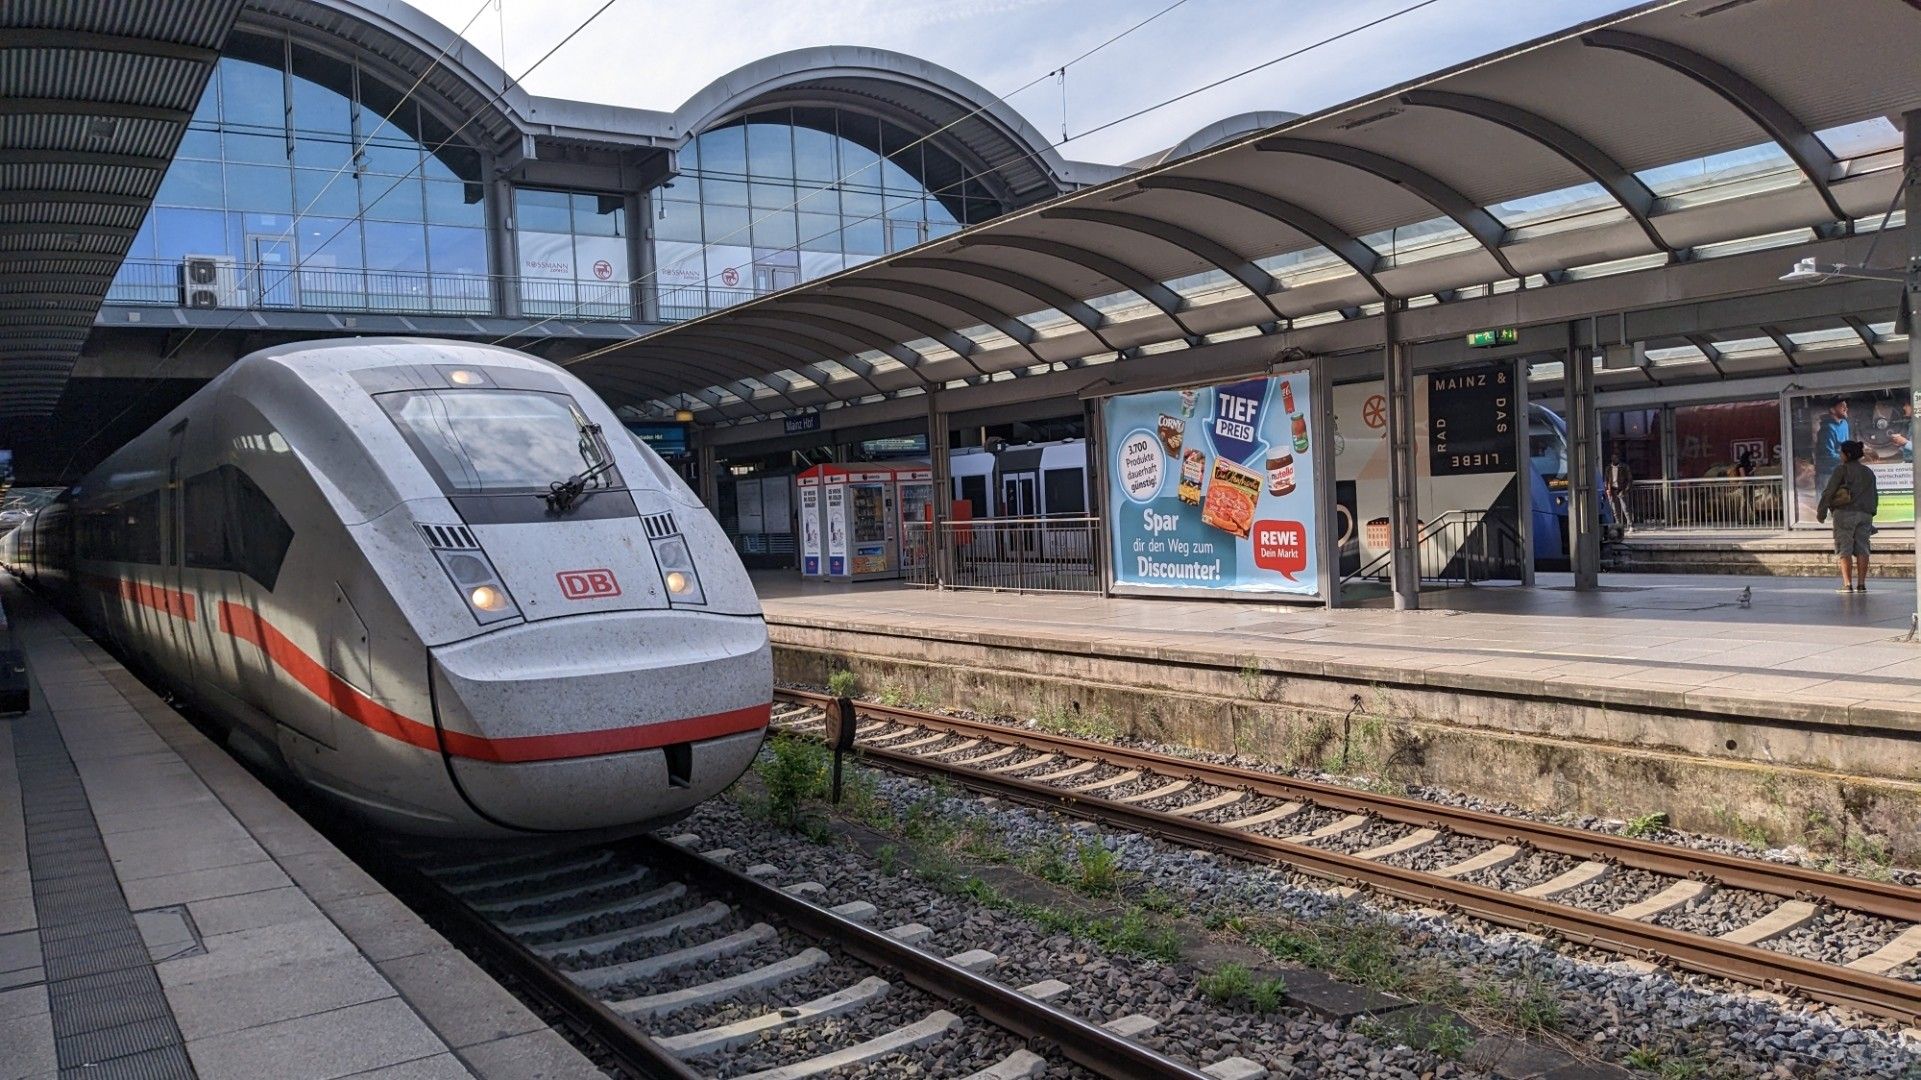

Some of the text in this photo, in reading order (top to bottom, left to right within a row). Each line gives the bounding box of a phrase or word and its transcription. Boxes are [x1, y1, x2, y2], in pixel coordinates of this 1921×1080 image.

[525, 260, 569, 270] ROSSMANN
[1435, 372, 1506, 391] MAINZ &
[1219, 392, 1259, 423] TIEF
[1495, 397, 1507, 433] DAS
[1158, 415, 1185, 433] CORNY
[1220, 420, 1251, 440] PREIS
[1436, 418, 1447, 452] RAD
[1127, 440, 1148, 455] 3.700
[1126, 453, 1155, 468] Produkte
[1451, 453, 1500, 467] LIEBE
[1127, 463, 1158, 480] dauerhaft
[1271, 466, 1294, 480] nutella
[1131, 475, 1158, 493] günstig!
[1143, 508, 1179, 536] Spar
[1261, 530, 1298, 546] REWE
[1133, 538, 1214, 557] dir den Weg zum
[1261, 547, 1299, 559] Dein Markt
[1137, 555, 1220, 581] Discounter!
[563, 572, 614, 596] DB
